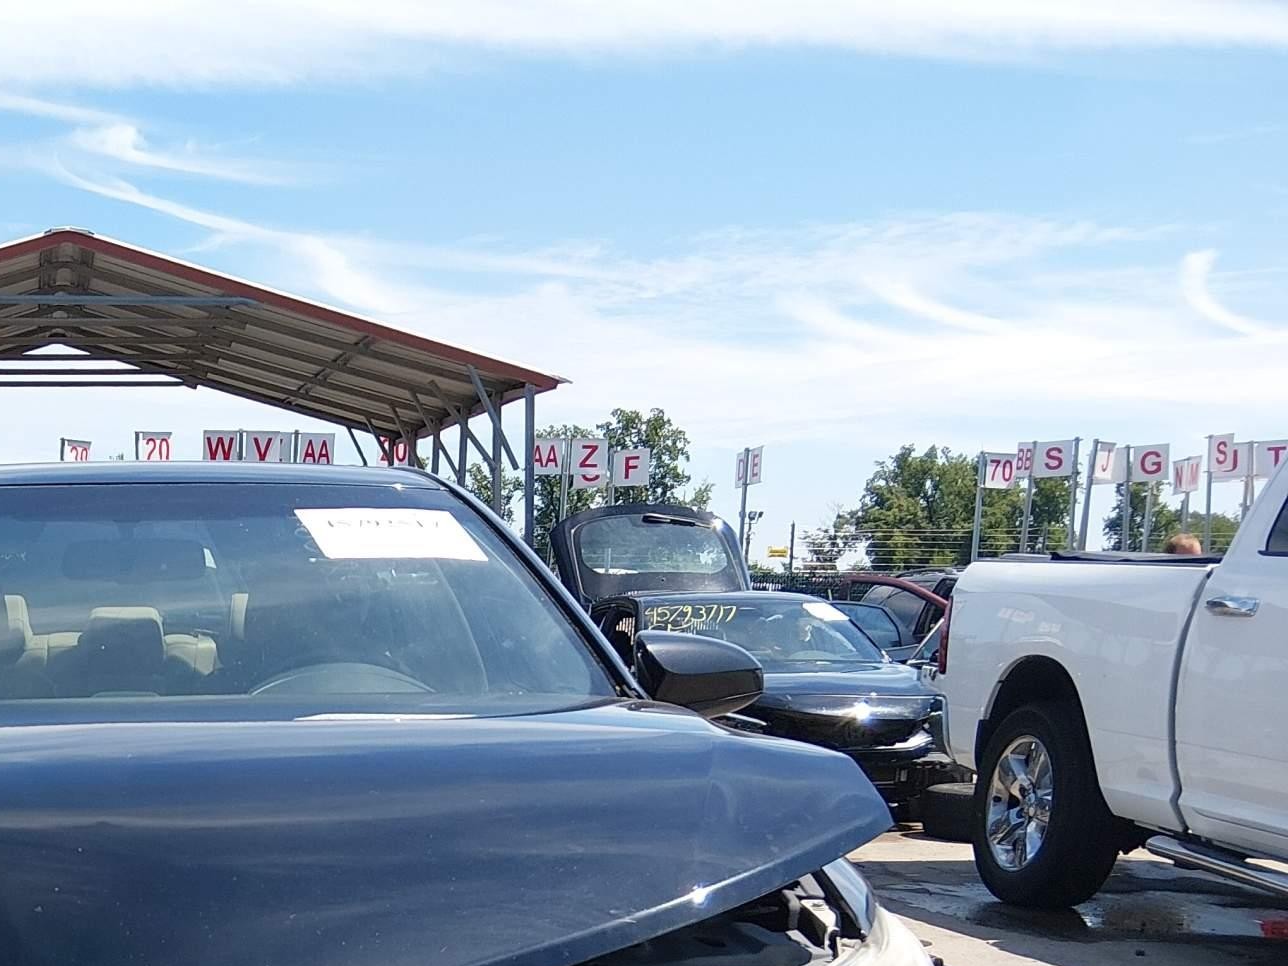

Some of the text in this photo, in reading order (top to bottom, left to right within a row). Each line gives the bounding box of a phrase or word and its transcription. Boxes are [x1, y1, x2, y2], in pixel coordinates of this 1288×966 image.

[145, 438, 170, 461] 20
[206, 437, 235, 461] W
[253, 437, 273, 461] V
[303, 439, 331, 464] AA
[534, 445, 558, 468] AA
[579, 445, 599, 468] Z
[1044, 447, 1063, 471] S
[1216, 441, 1228, 465] S
[624, 456, 640, 480] F
[752, 454, 760, 478] E
[990, 459, 1014, 481] 70
[1140, 450, 1162, 475] G
